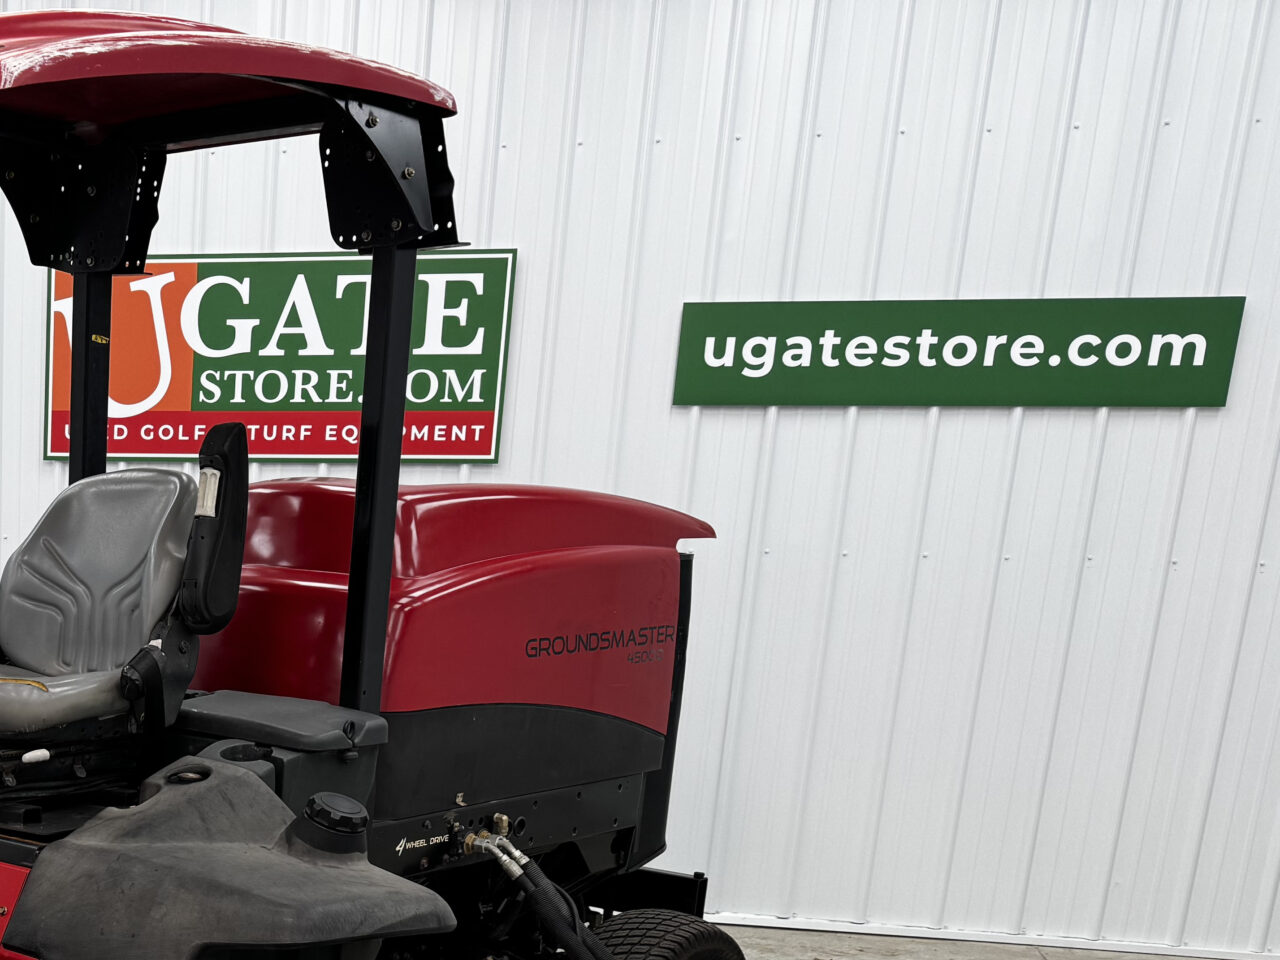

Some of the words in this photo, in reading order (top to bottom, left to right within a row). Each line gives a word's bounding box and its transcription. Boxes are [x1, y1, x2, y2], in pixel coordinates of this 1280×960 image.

[702, 328, 1208, 378] ugatestore.com
[198, 368, 487, 403] STORE.OM
[140, 424, 207, 440] GOLF
[247, 425, 313, 441] TURF
[324, 424, 486, 444] EQMENT
[525, 625, 676, 658] GROUNDSMASTER
[395, 837, 407, 856] 4
[405, 840, 428, 850] WHEEL
[429, 834, 450, 845] DRIVE
